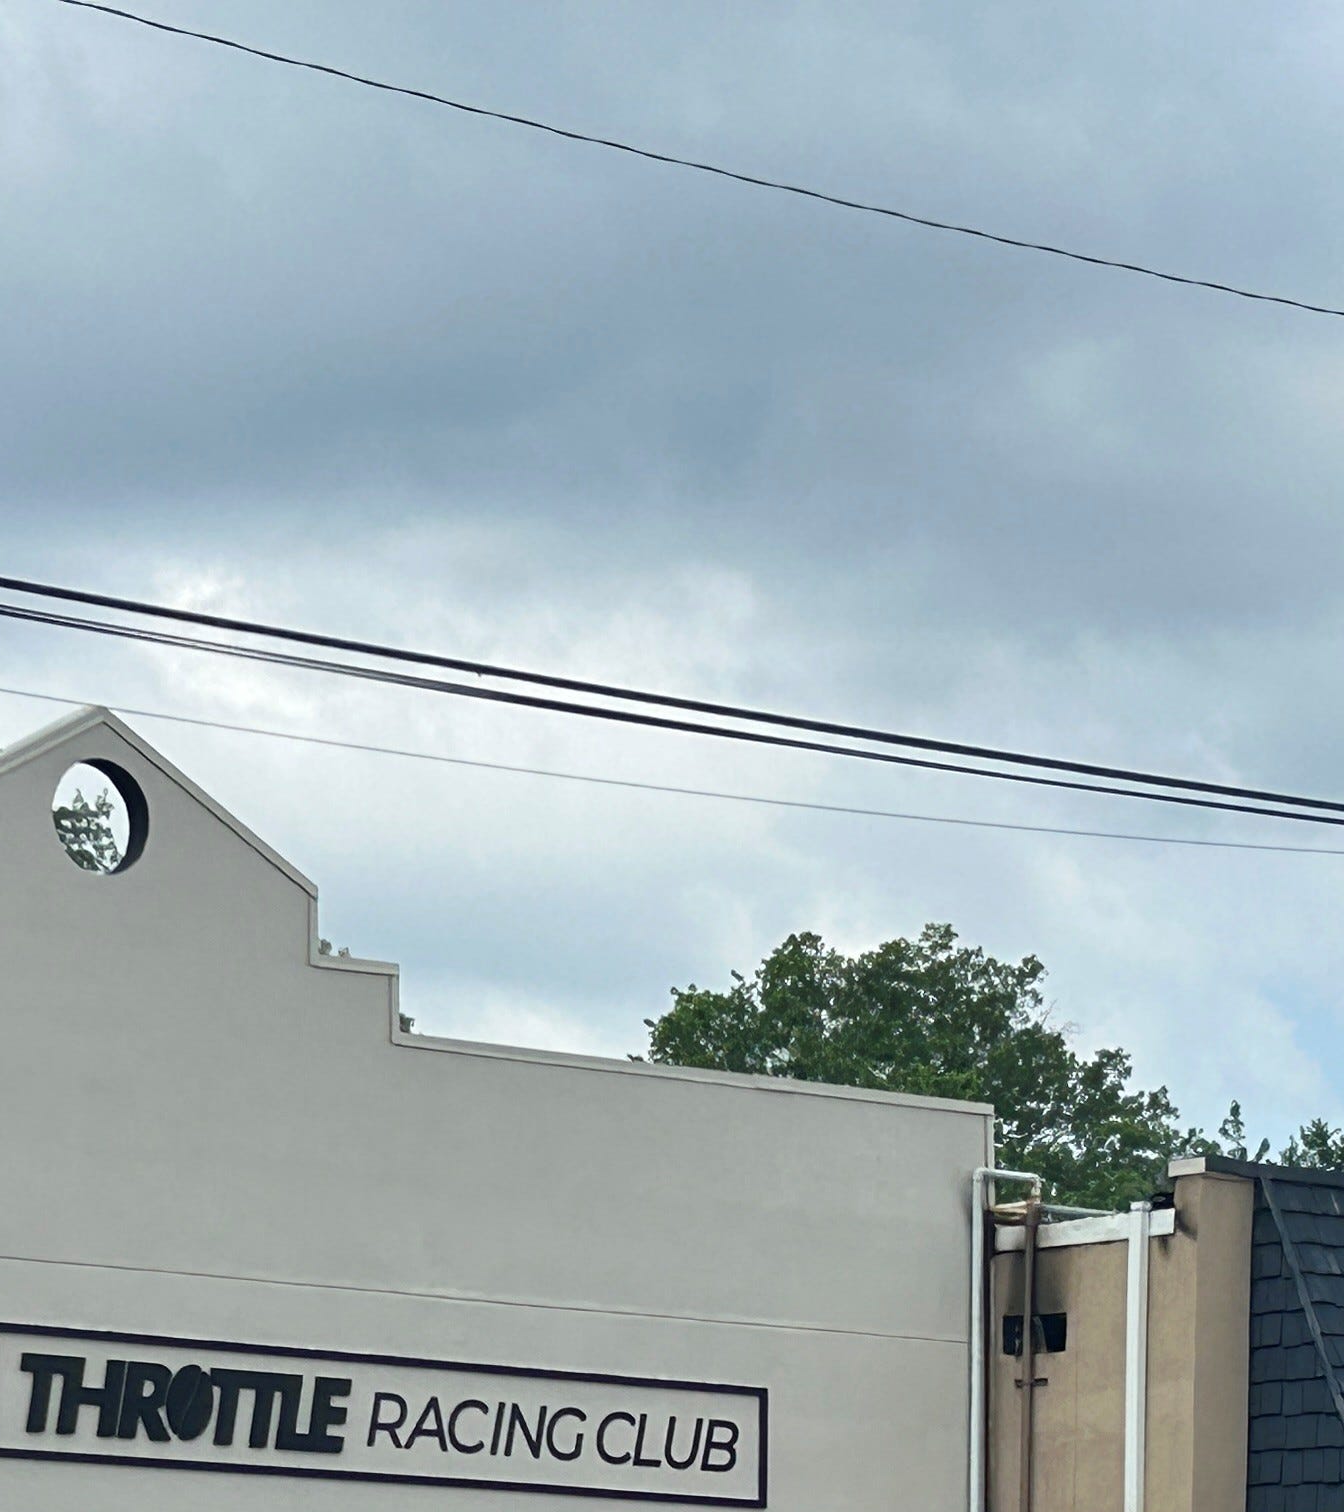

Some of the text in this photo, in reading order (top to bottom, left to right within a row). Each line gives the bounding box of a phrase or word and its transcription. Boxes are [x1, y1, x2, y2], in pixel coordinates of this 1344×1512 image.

[19, 1352, 740, 1473] THROTTLE RACING CLUB
